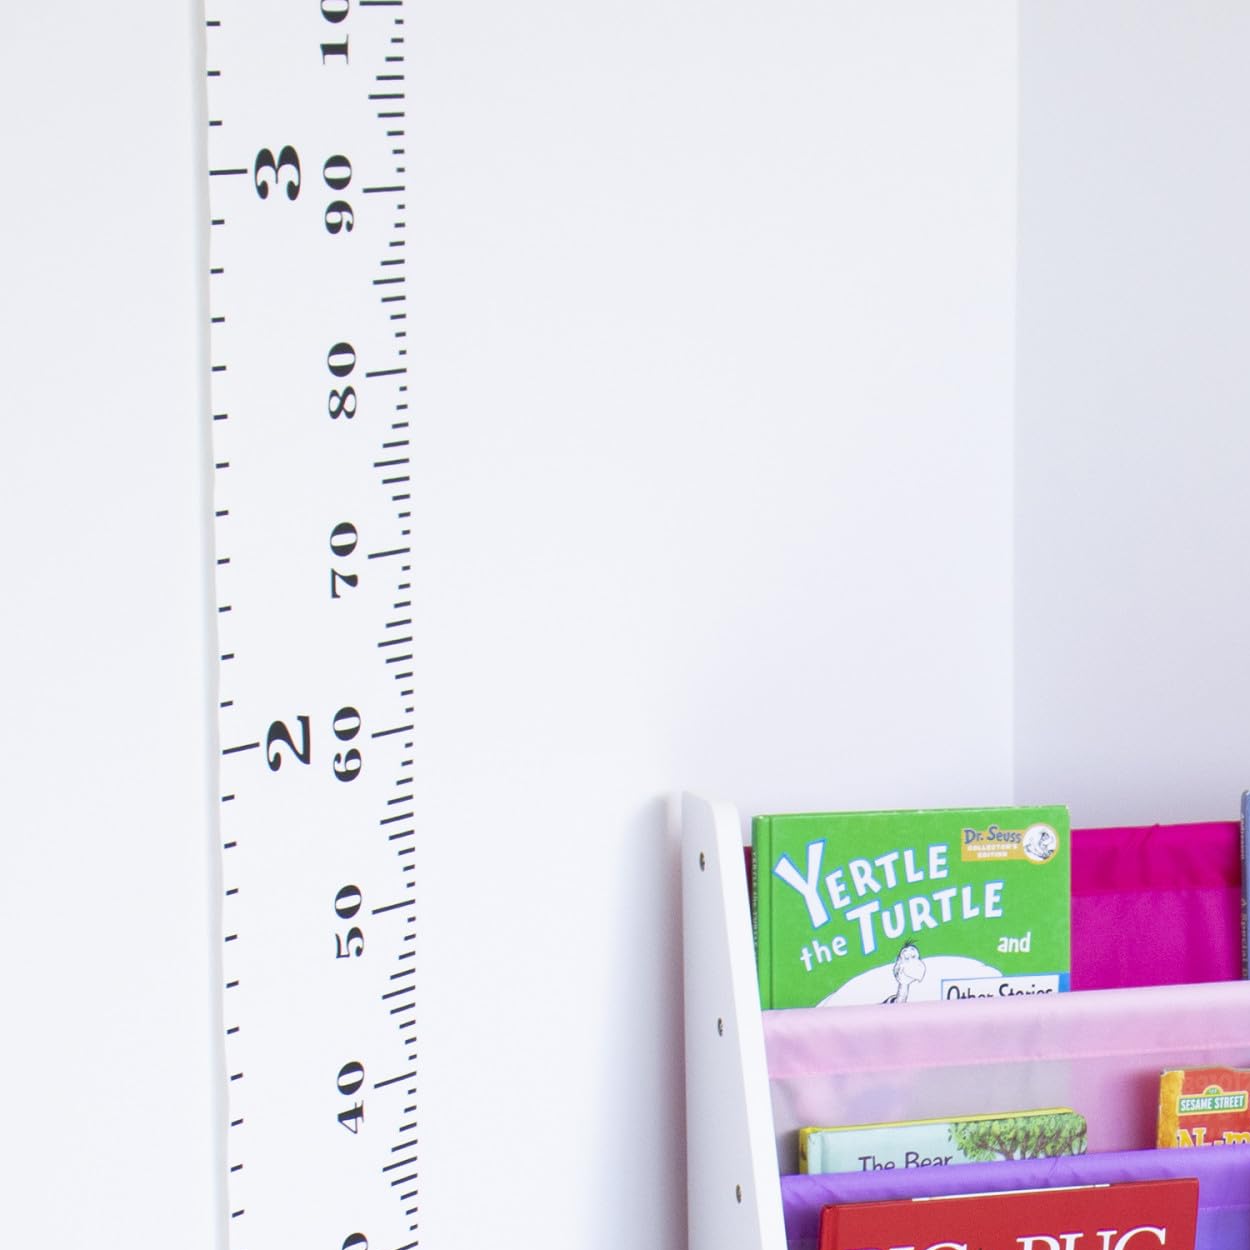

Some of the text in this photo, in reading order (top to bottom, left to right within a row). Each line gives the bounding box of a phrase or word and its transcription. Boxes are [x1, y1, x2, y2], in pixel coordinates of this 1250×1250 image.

[254, 145, 301, 201] 3
[323, 154, 354, 235] 90
[327, 342, 357, 420] 80
[330, 522, 359, 599] 70
[266, 715, 311, 772] 2
[333, 706, 362, 783] 60
[963, 825, 1023, 845] Dr. Seuss
[334, 884, 364, 960] 50
[772, 838, 949, 930] YERTLE
[799, 880, 1006, 972] the TURTLE
[997, 930, 1032, 953] and
[337, 1061, 366, 1135] 40
[1180, 1095, 1245, 1112] SESAME STREET
